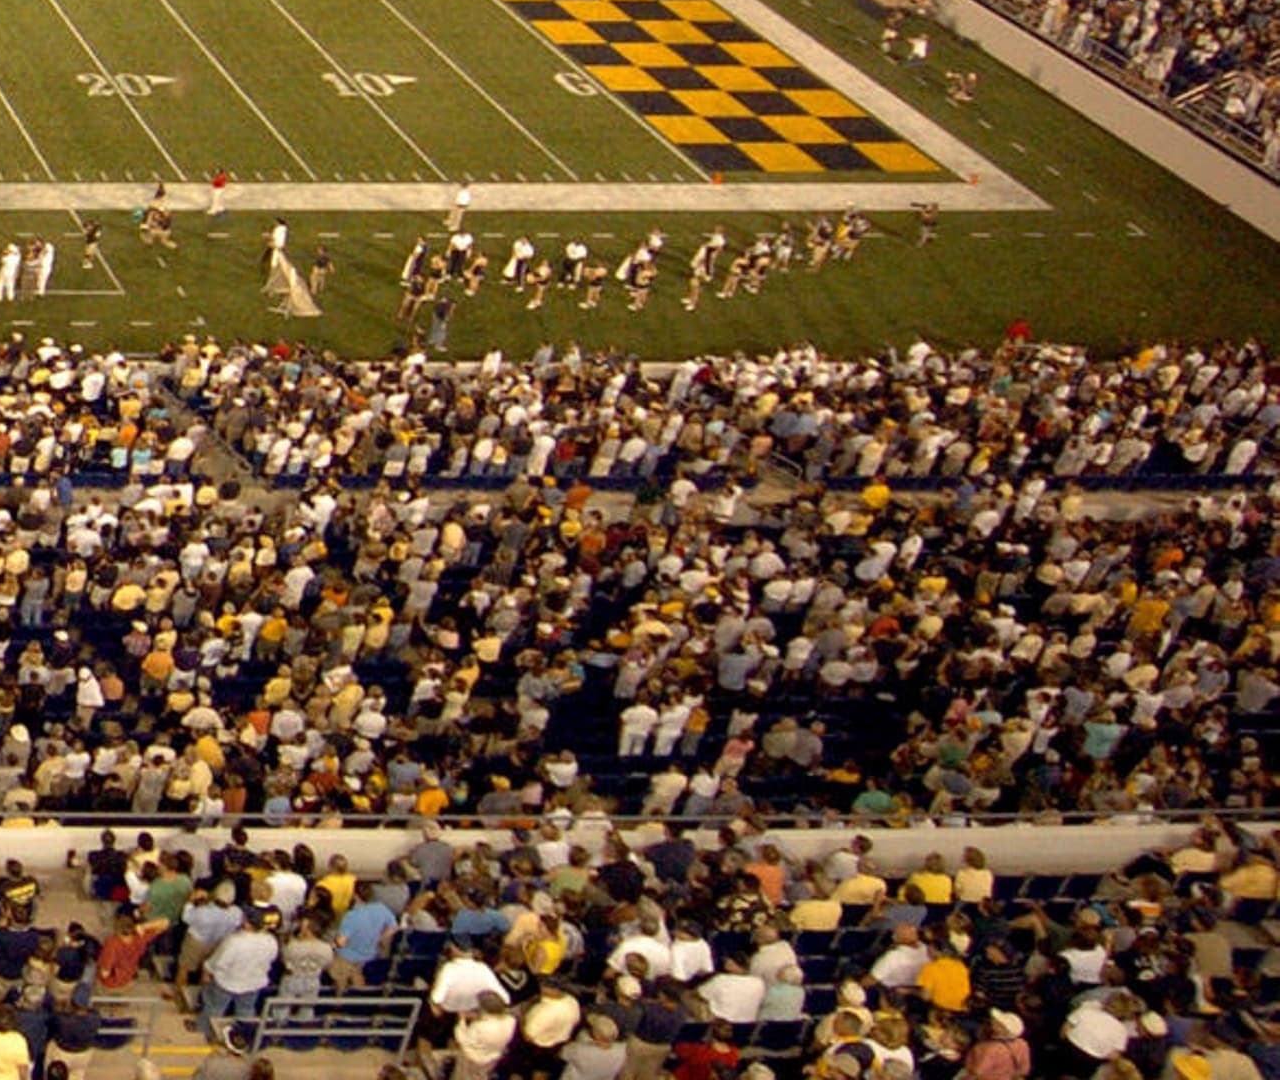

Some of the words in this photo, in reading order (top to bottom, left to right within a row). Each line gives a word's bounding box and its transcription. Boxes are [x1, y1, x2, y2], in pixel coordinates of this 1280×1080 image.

[75, 71, 153, 99] 20
[321, 71, 396, 98] 10
[552, 70, 601, 98] G
